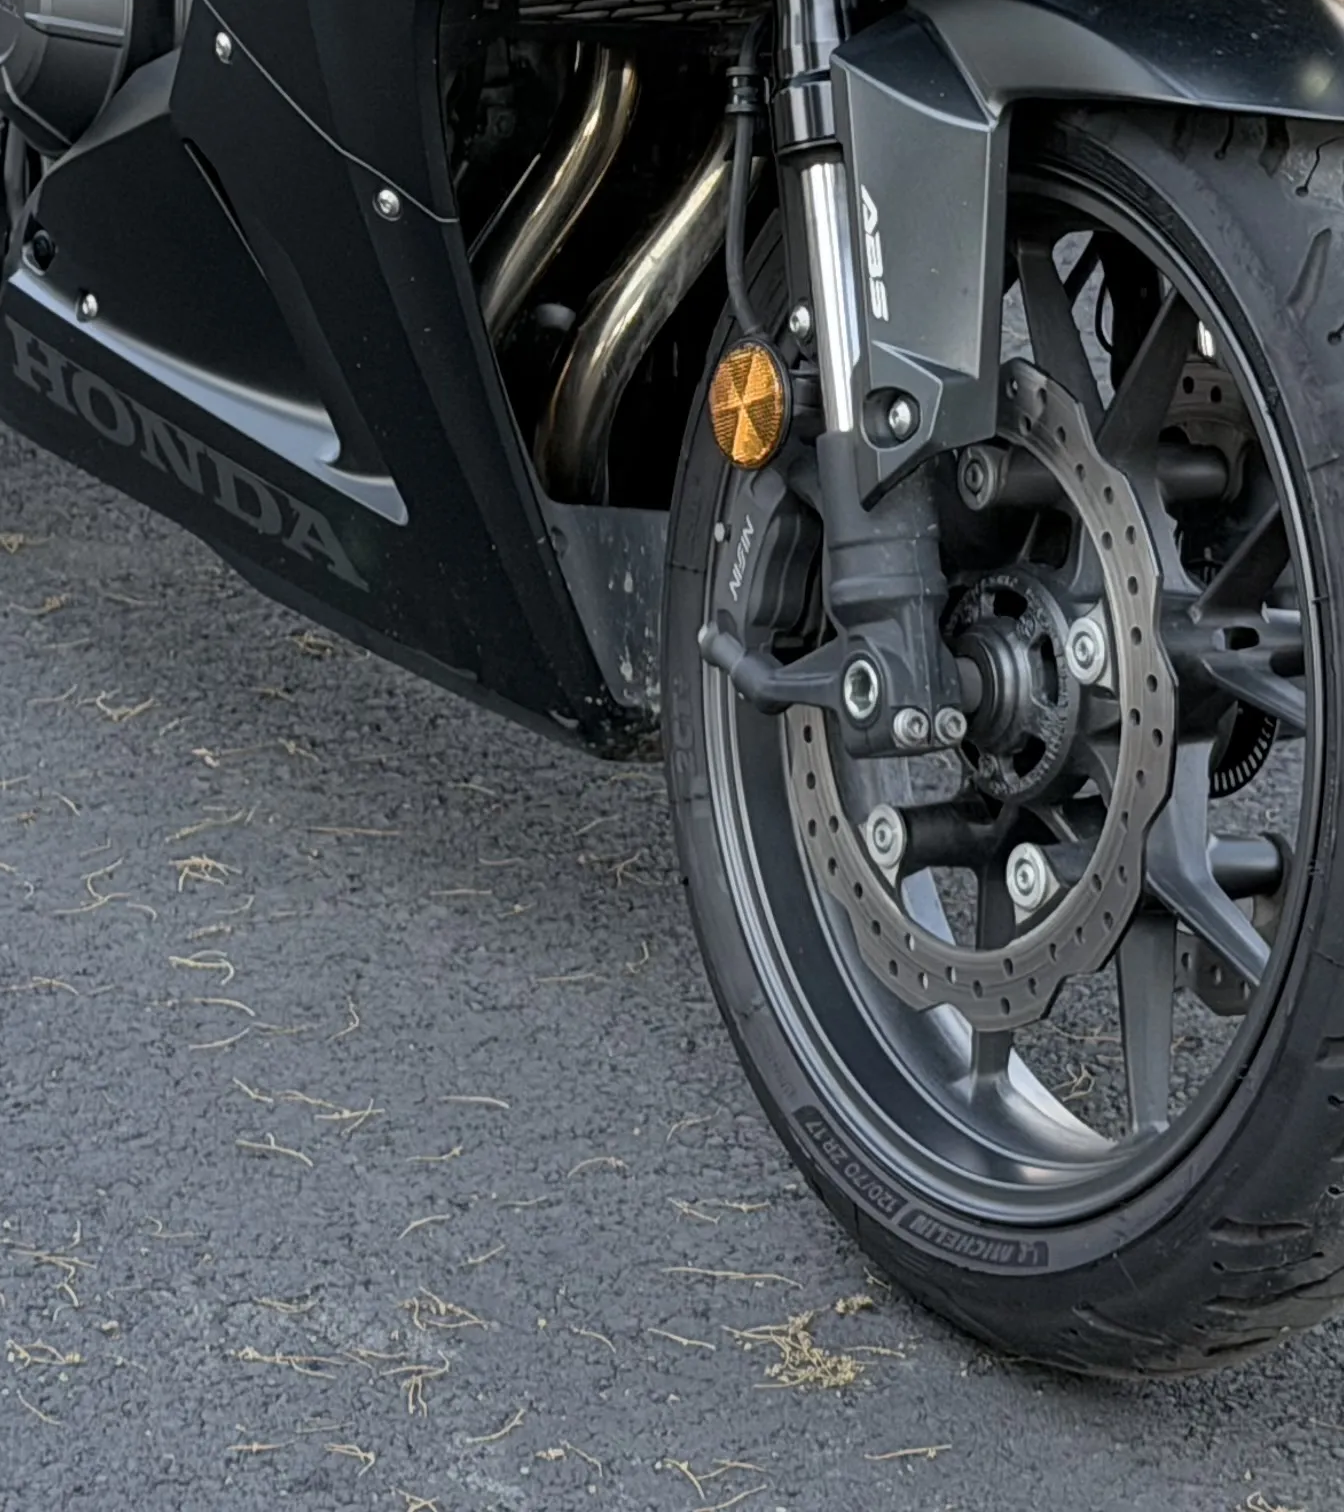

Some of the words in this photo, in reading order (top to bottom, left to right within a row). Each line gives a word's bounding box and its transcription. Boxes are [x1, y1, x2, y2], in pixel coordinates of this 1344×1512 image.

[860, 183, 890, 323] ABS
[5, 313, 371, 593] HONDA
[805, 1120, 828, 1141] 17
[822, 1137, 849, 1165] ZR
[844, 1161, 898, 1213] 120/70
